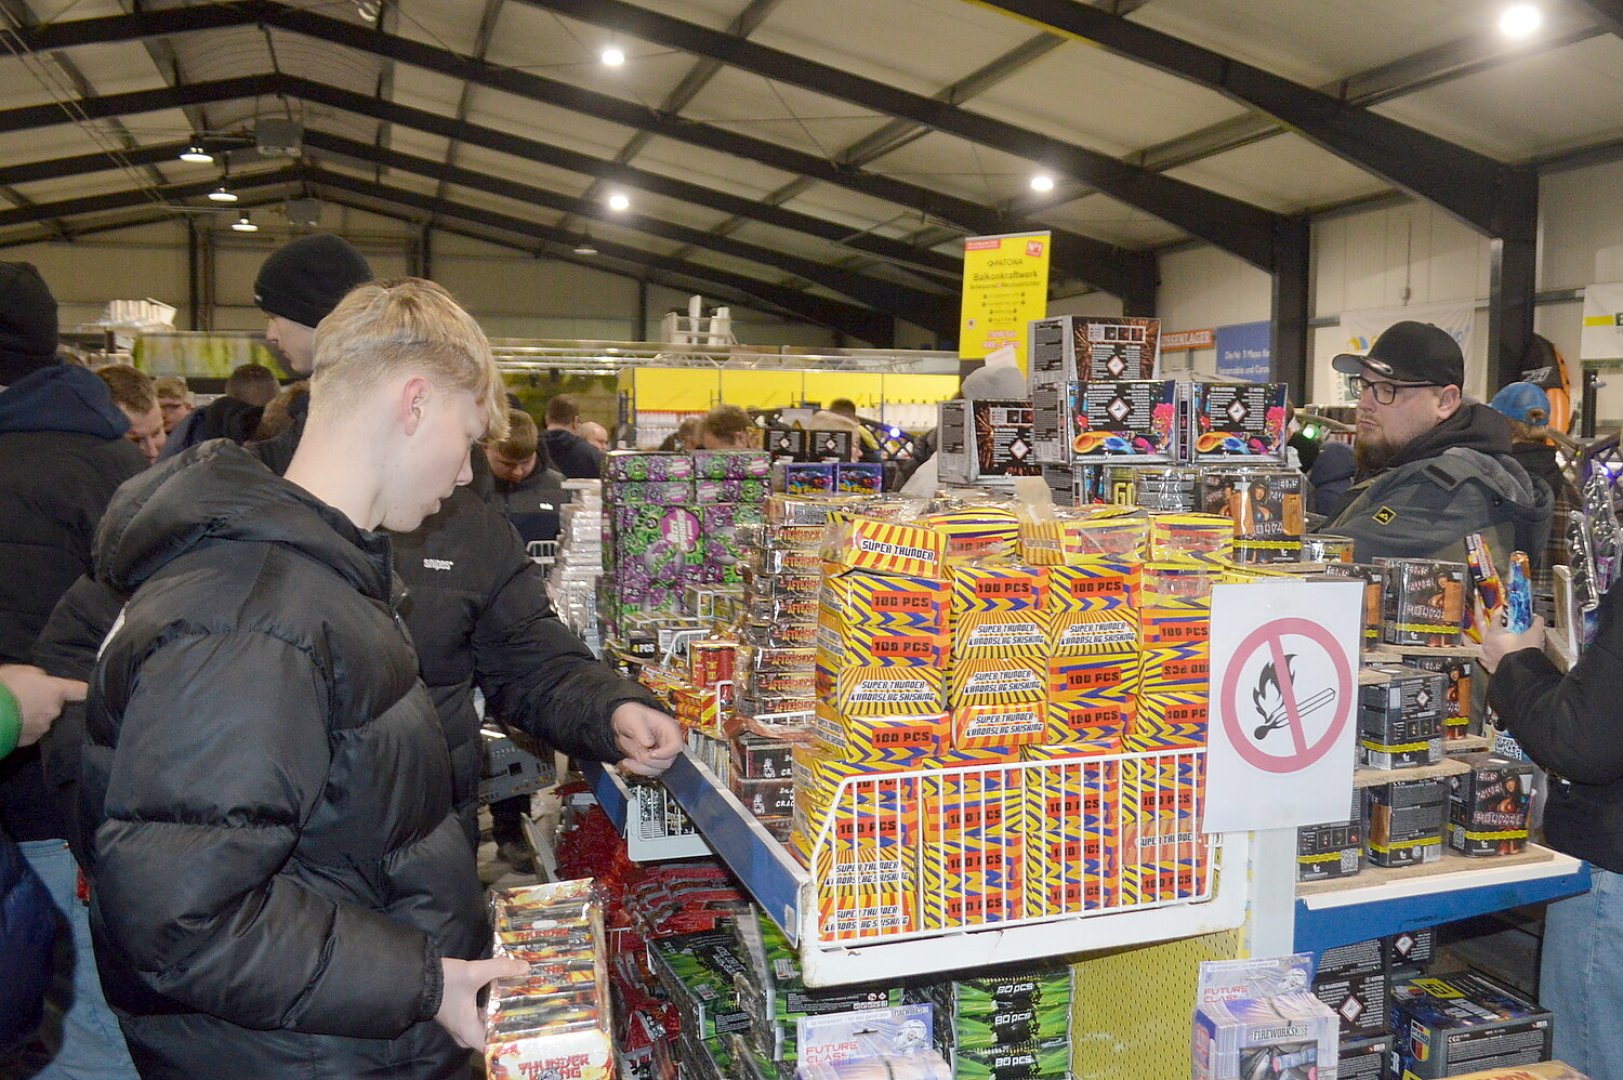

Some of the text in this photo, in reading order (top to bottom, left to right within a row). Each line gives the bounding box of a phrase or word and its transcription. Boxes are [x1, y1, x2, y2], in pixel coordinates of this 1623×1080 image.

[862, 540, 934, 560] SUPER THUNDER
[423, 558, 454, 571] snipes
[979, 583, 1029, 593] 100 PCS
[1073, 581, 1121, 593] 100 PCS
[874, 596, 929, 607] 100 PCS
[978, 623, 1035, 633] SUPER THUNDER
[1070, 622, 1126, 633] SUPER THUNDER
[1162, 627, 1208, 636] 100 PCS
[640, 643, 655, 653] PCS
[875, 641, 930, 652] 100 PCS
[974, 670, 1031, 682] SUPER THUNDER
[1069, 672, 1120, 685] 100 PCS
[861, 681, 925, 689] SUPER THUNDER
[976, 713, 1034, 724] SUPER THUNDER
[1071, 711, 1118, 724] 100 PCS
[1167, 709, 1207, 720] 100 PC
[875, 731, 930, 743] 100 PCS
[1143, 793, 1190, 806] 100 PCS
[869, 820, 897, 831] PCS
[1137, 832, 1197, 846] UPER THUNDE
[1054, 847, 1075, 857] 10
[836, 864, 861, 873] SUPER
[836, 909, 861, 919] SUPER
[1013, 982, 1033, 993] pcs
[1203, 985, 1248, 995] FUTURE
[995, 1012, 1031, 1025] 80 pcs
[806, 1041, 858, 1055] FUTURE
[995, 1055, 1032, 1067] 80 pcs
[529, 1067, 582, 1080] KNG
